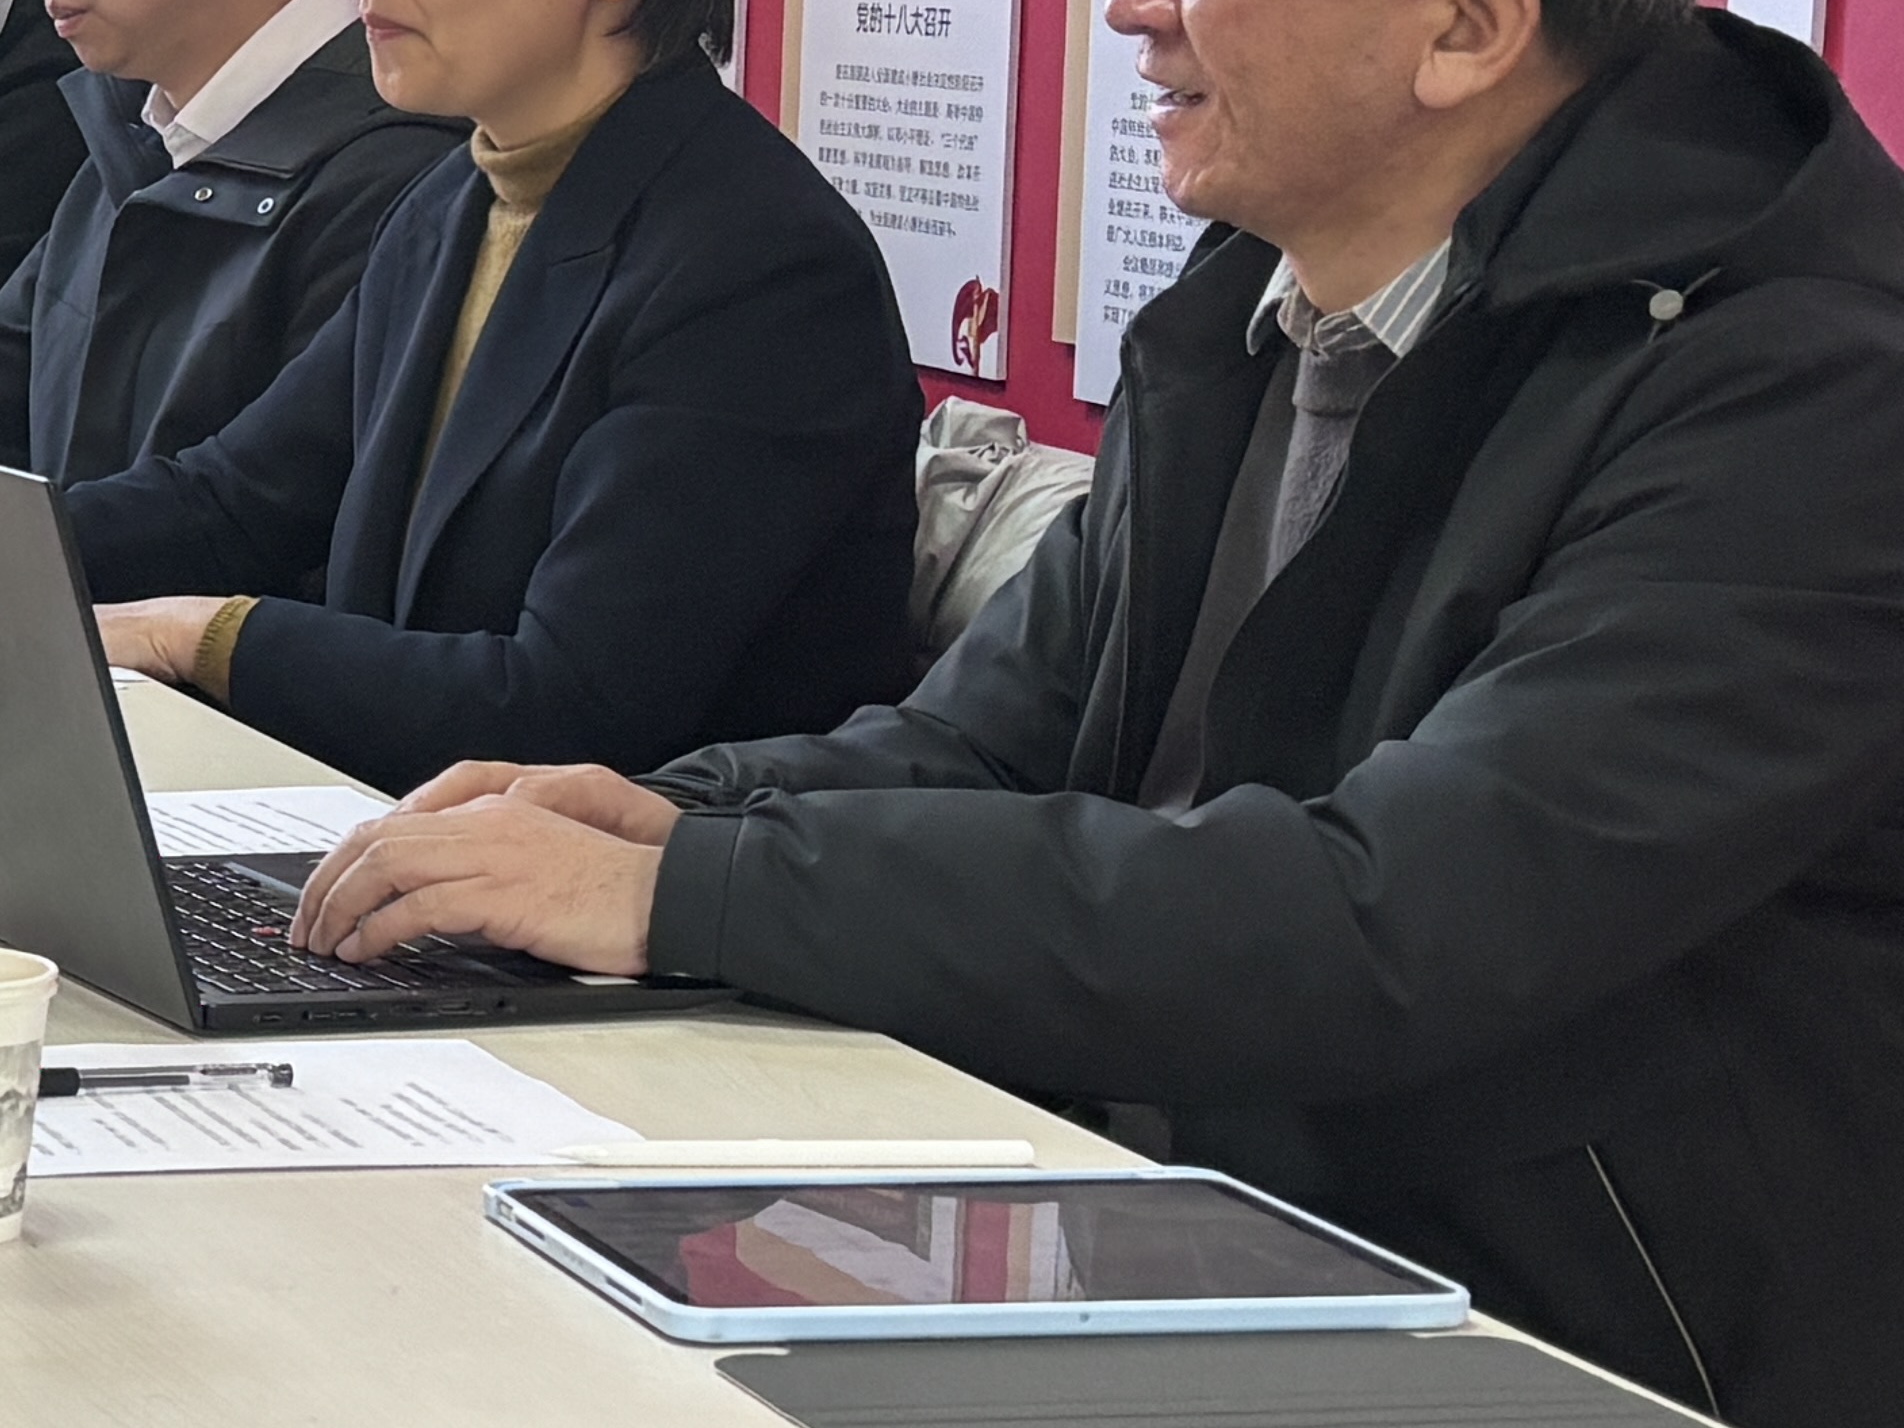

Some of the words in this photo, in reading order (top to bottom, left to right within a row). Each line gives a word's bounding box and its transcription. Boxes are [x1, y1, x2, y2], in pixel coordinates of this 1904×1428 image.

[856, 2, 952, 38] 党的十八大召开
